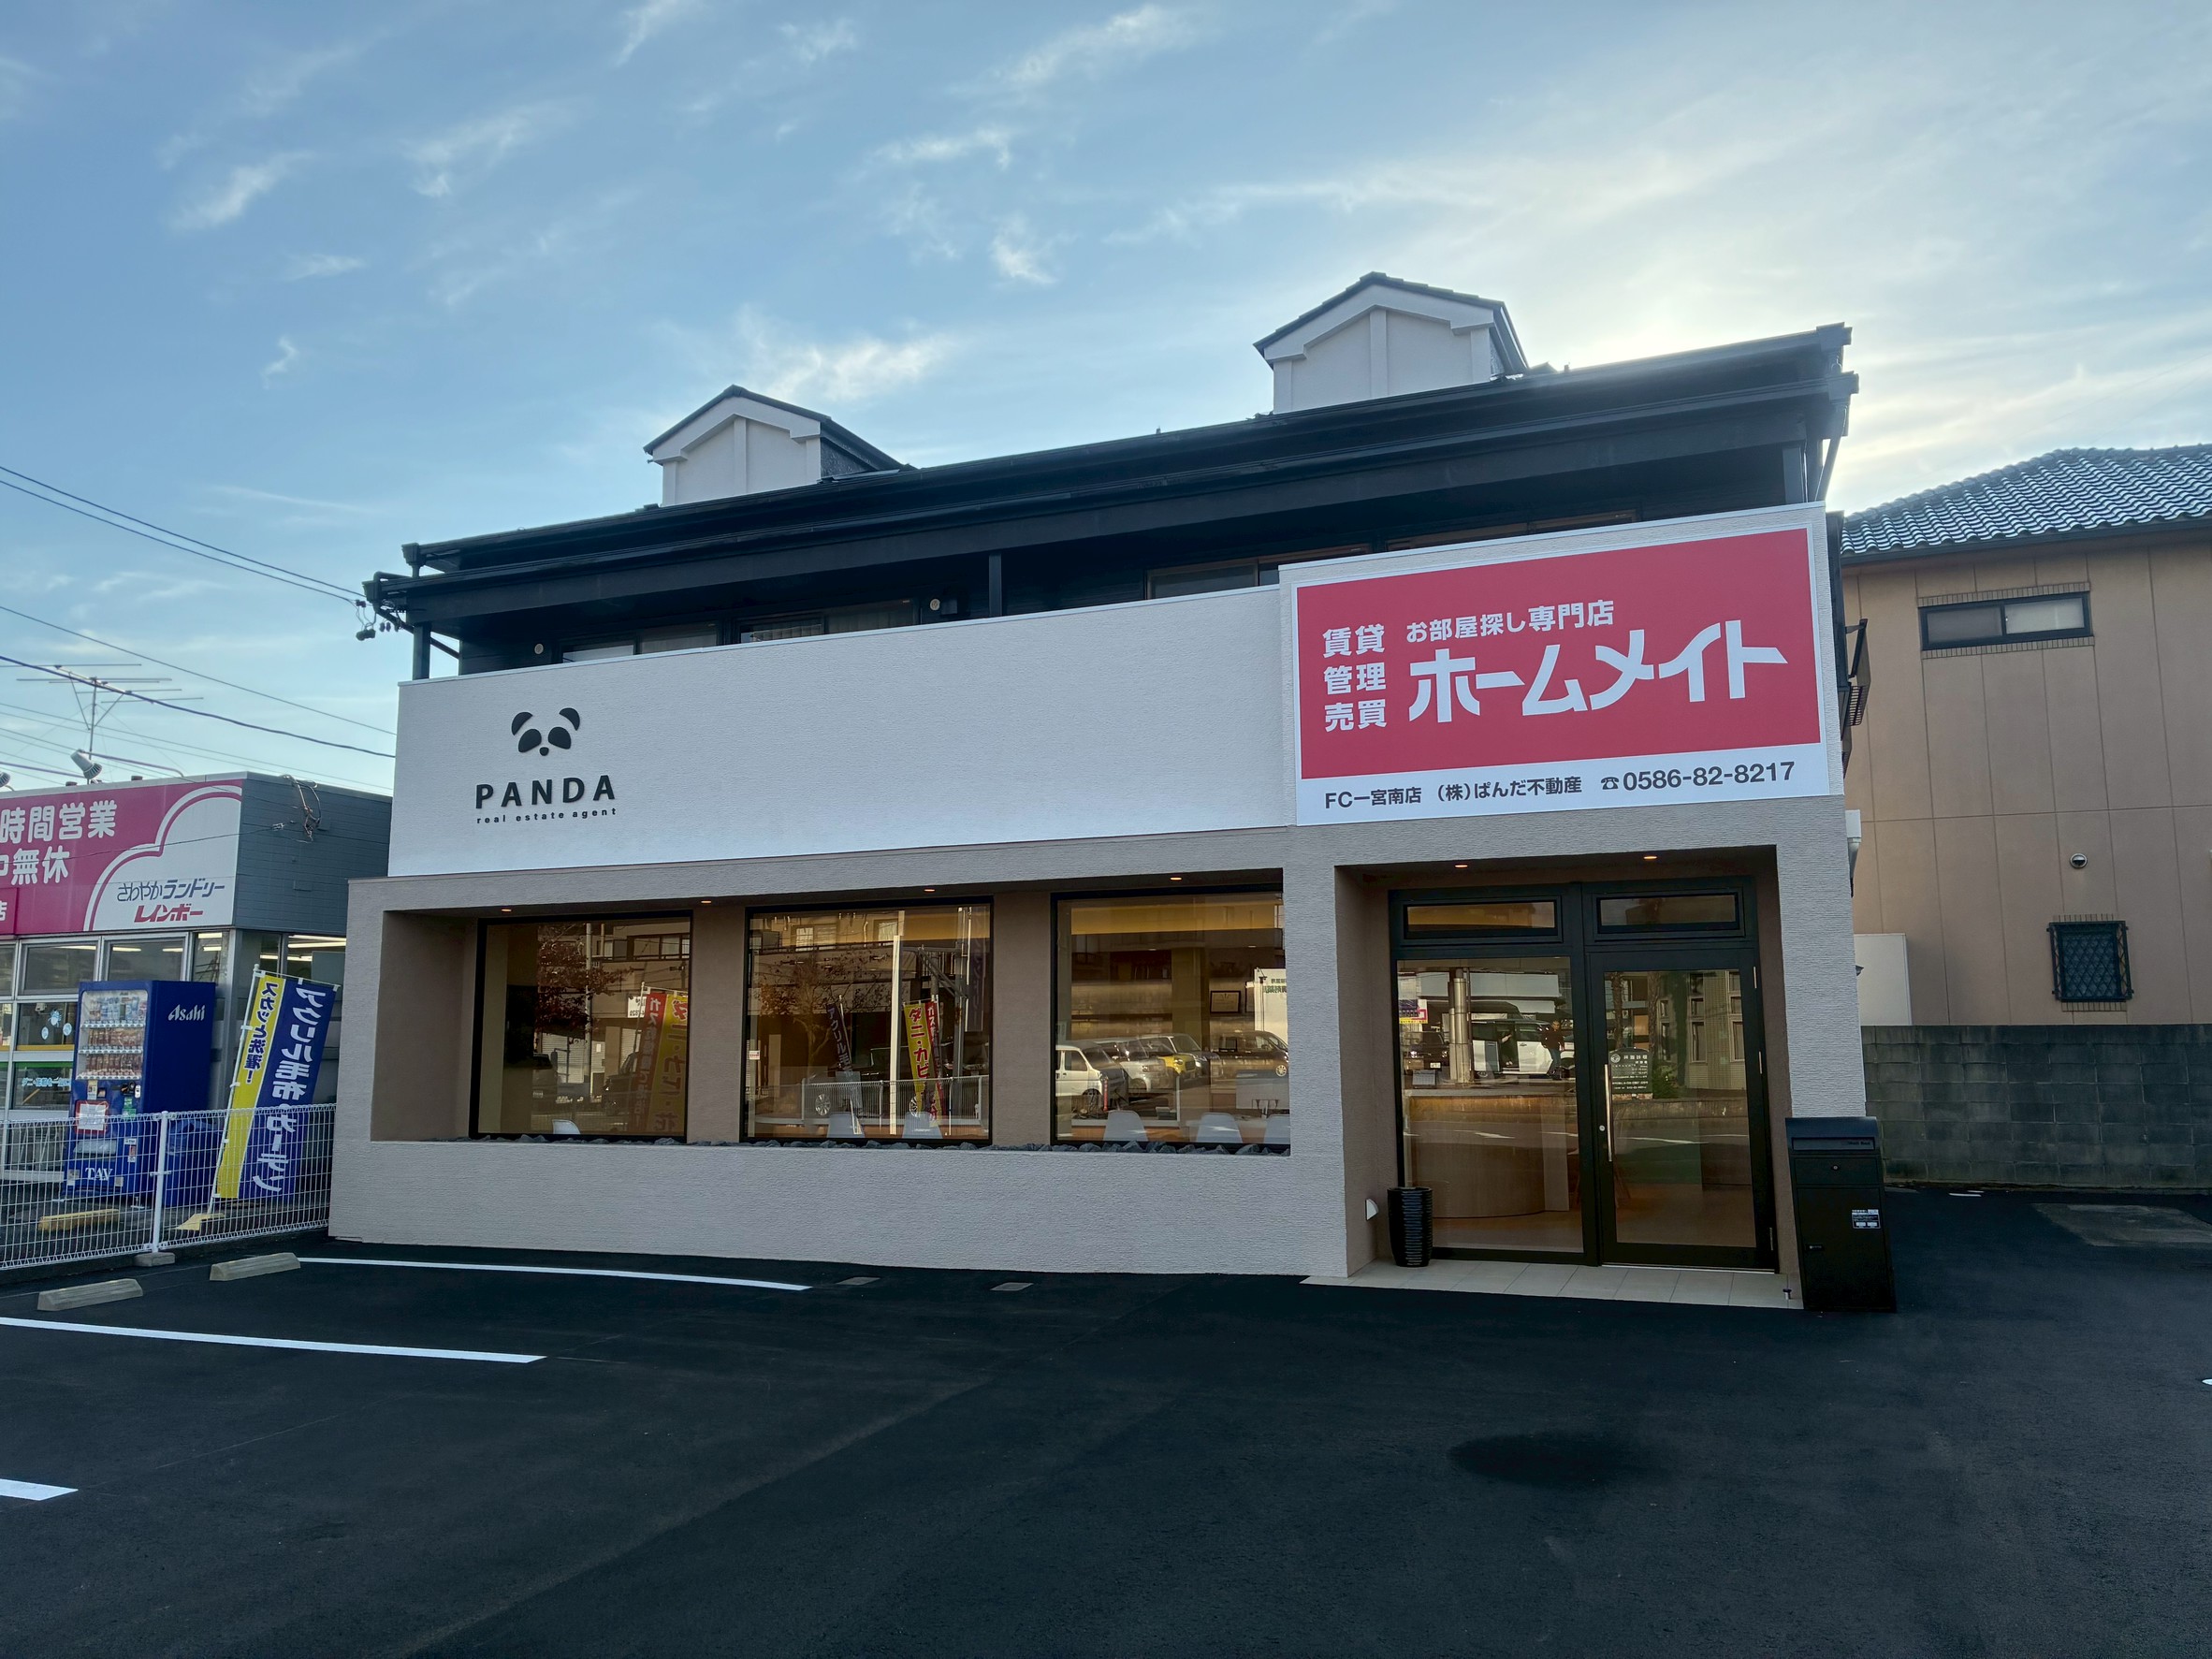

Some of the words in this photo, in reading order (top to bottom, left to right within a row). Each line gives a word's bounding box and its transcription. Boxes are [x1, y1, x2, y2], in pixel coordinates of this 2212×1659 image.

[1406, 600, 1615, 644] お部屋探し専門店
[1322, 623, 1385, 659] 賃貸
[1323, 662, 1388, 696] 管理
[1408, 619, 1788, 724] ホームメイト
[1324, 698, 1389, 733] 売買
[475, 775, 615, 808] PANDA
[476, 814, 506, 824] real
[516, 811, 564, 822] estate
[572, 808, 617, 819] agent
[134, 903, 204, 923] レインボー
[167, 1004, 206, 1022] Asahi
